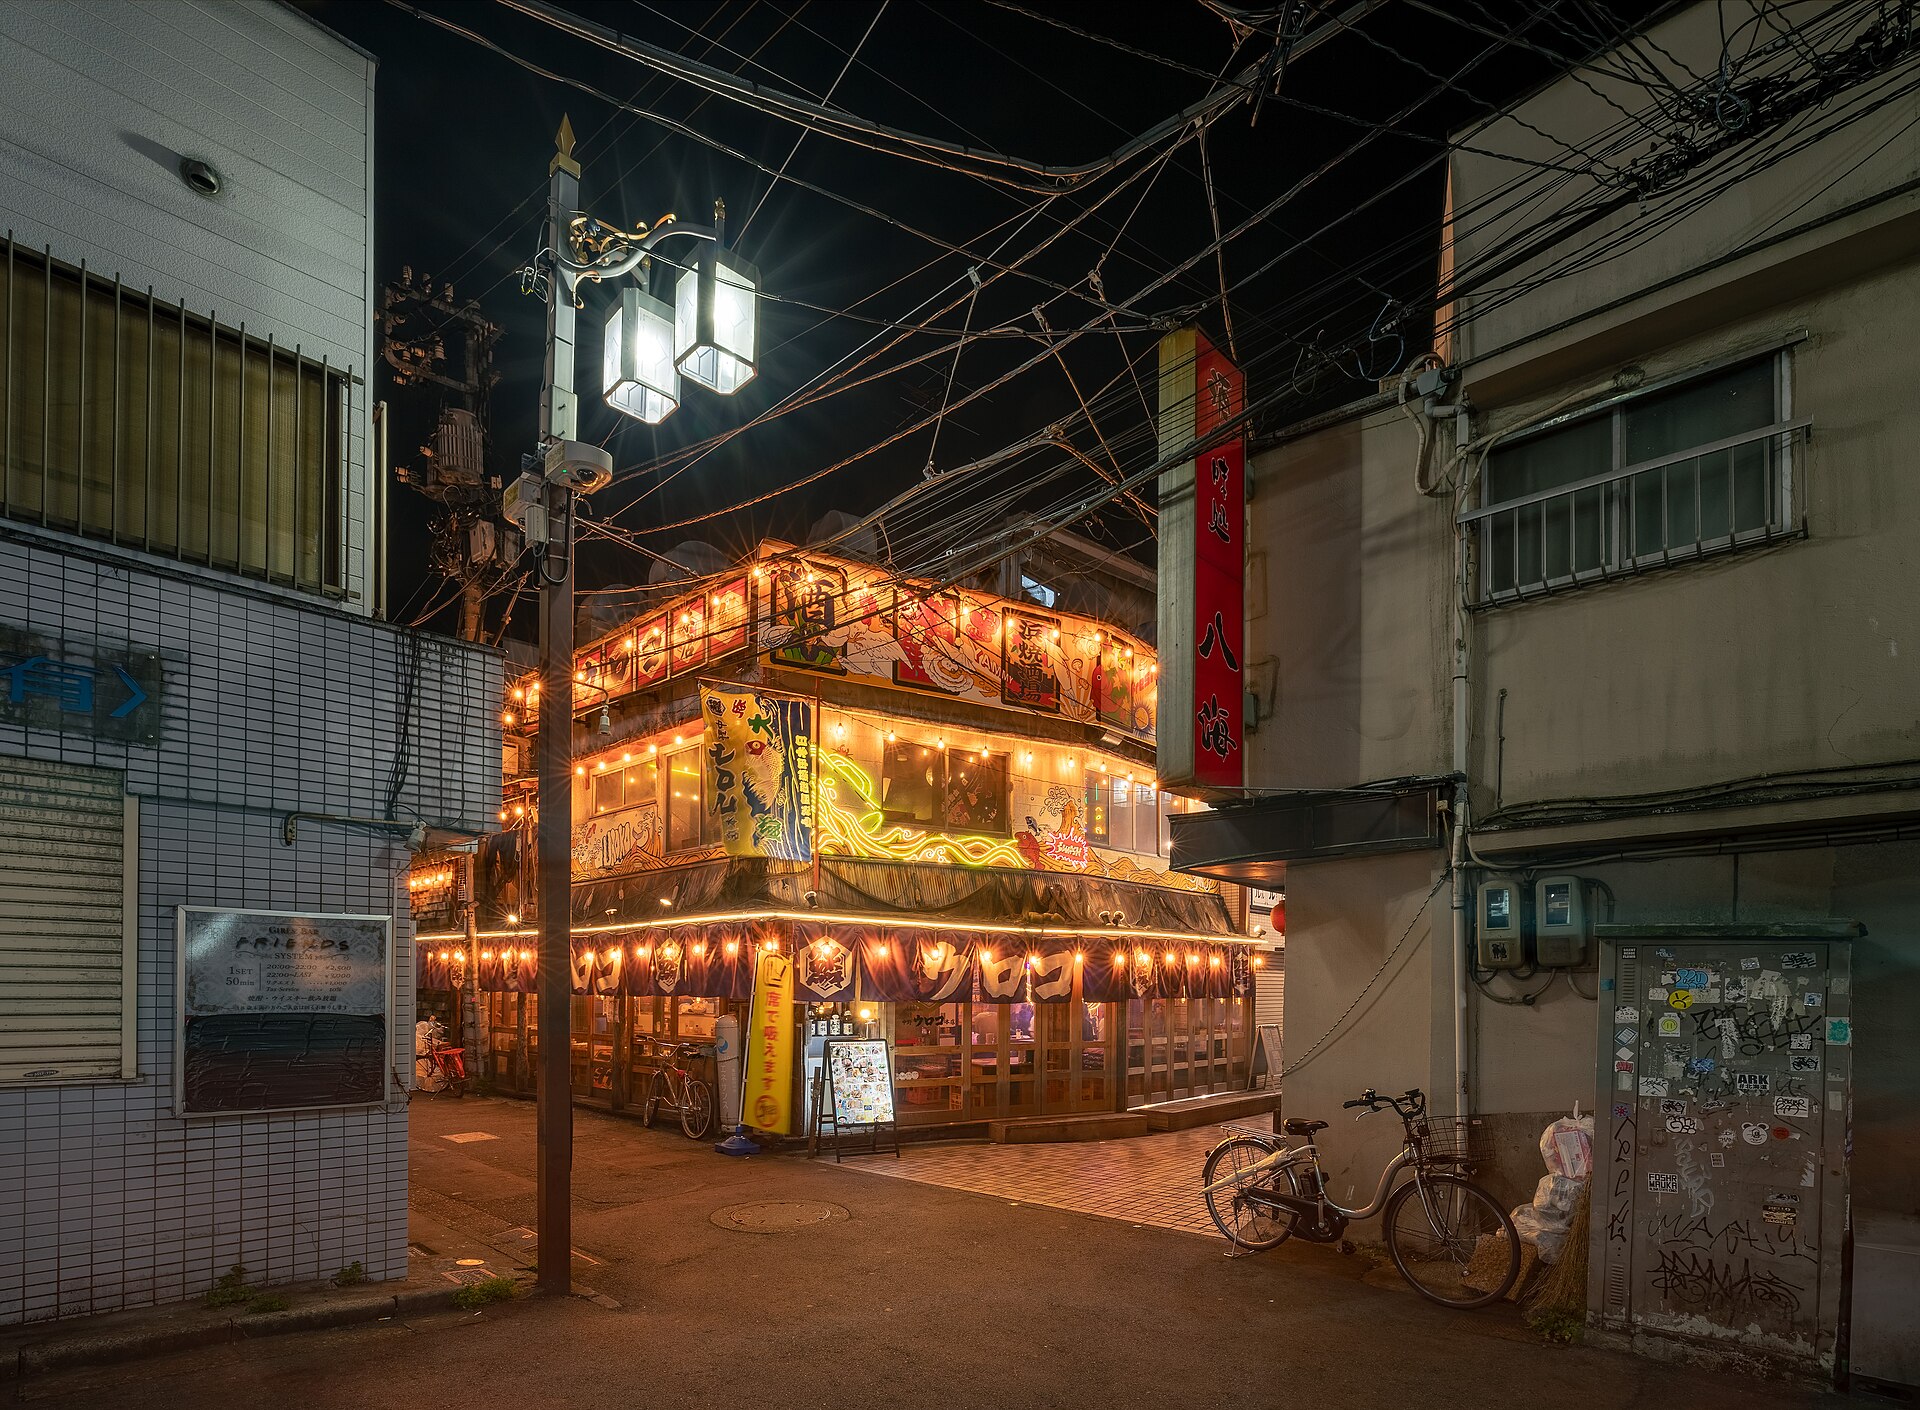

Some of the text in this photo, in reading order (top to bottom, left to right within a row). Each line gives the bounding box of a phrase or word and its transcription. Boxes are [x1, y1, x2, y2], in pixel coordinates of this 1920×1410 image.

[970, 640, 1014, 684] YAMMY
[1017, 619, 1044, 704] 浜焼酒場
[274, 952, 313, 961] SYSTEM
[921, 941, 1074, 1000] ウロコ
[1737, 1074, 1769, 1085] ARK
